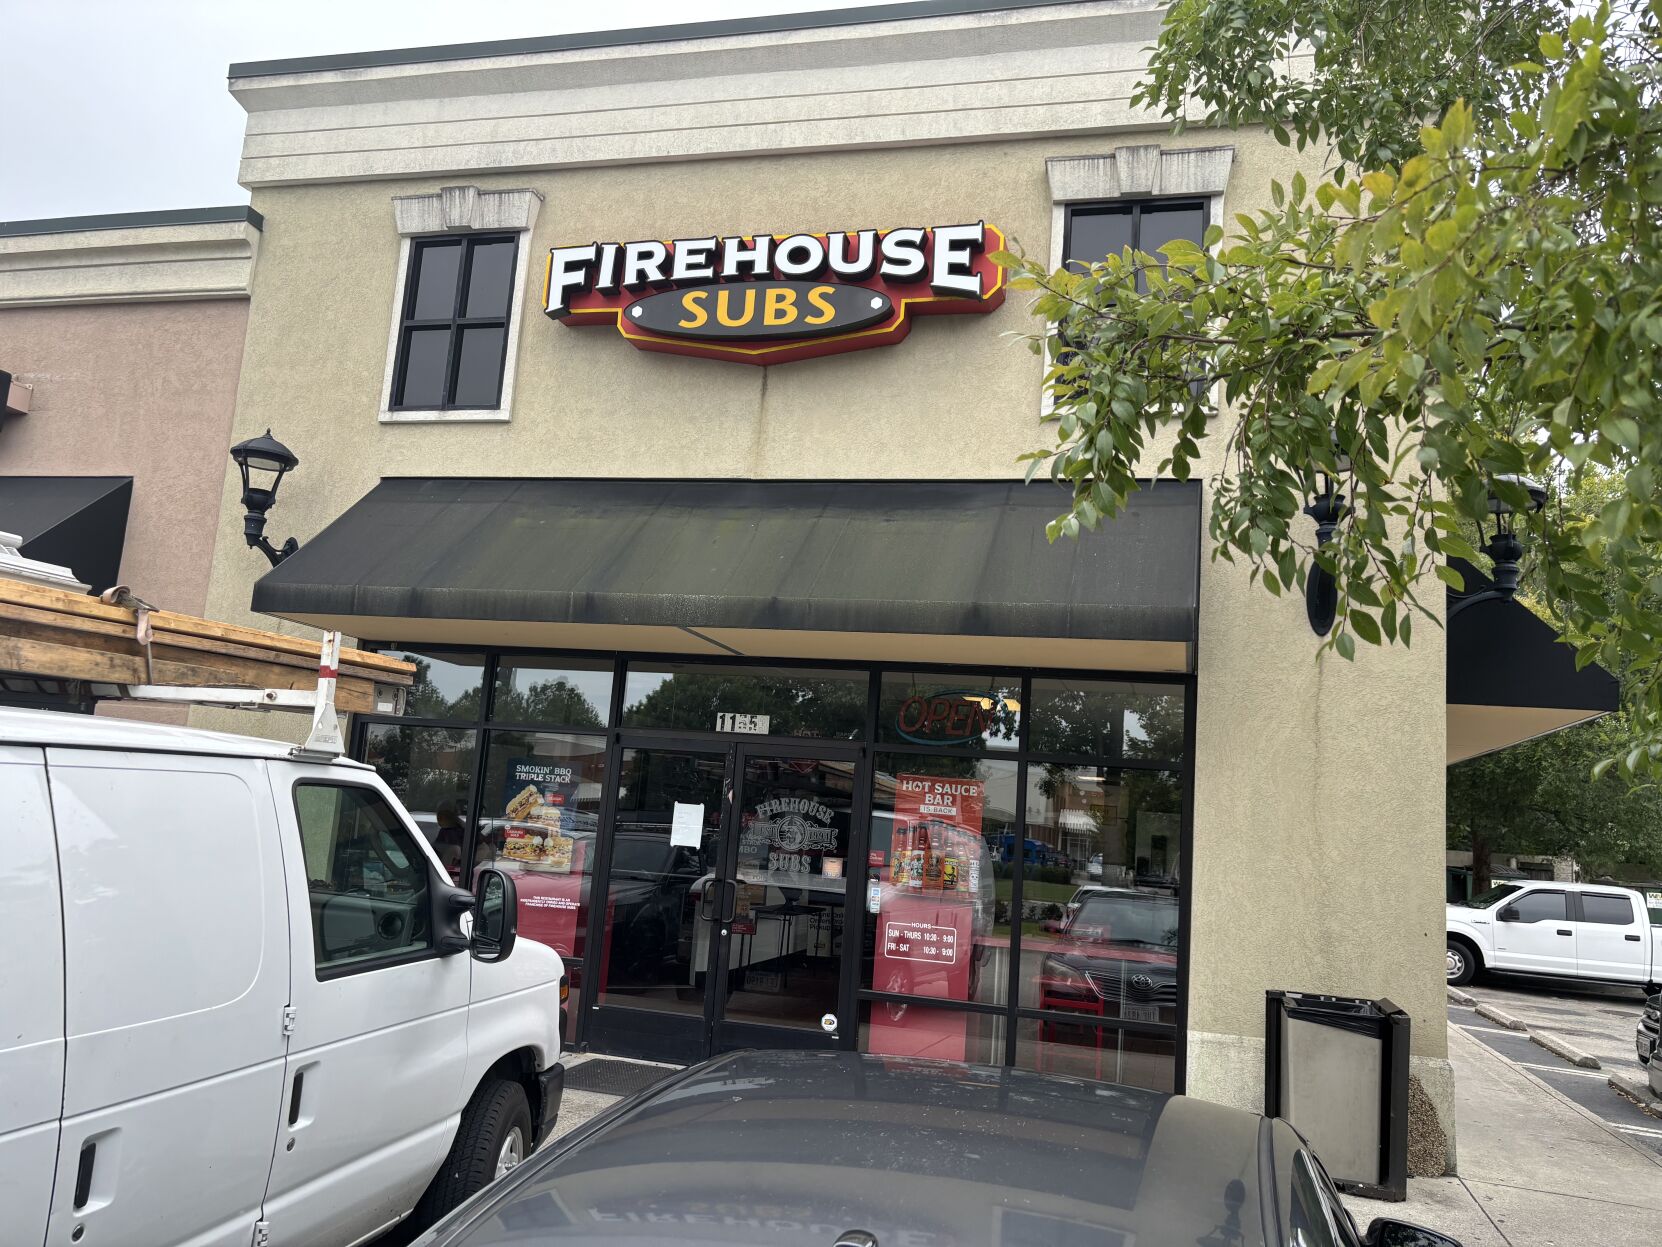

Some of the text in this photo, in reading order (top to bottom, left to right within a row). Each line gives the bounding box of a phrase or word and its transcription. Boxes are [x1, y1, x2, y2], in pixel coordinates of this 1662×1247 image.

[546, 220, 986, 315] FIREHOUSE
[678, 284, 837, 328] SUBS
[899, 696, 993, 736] OPEN
[515, 764, 572, 777] SMOKIN' BBQ
[515, 772, 571, 784] TRIPLE STACK
[902, 780, 978, 796] HOT SAUCE
[924, 794, 953, 806] BAR
[755, 797, 835, 825] FIREHOUSE
[933, 806, 953, 814] BACK
[768, 852, 812, 874] SUBS
[904, 930, 922, 940] THURS
[943, 935, 954, 943] 9:00
[899, 943, 910, 952] SAT
